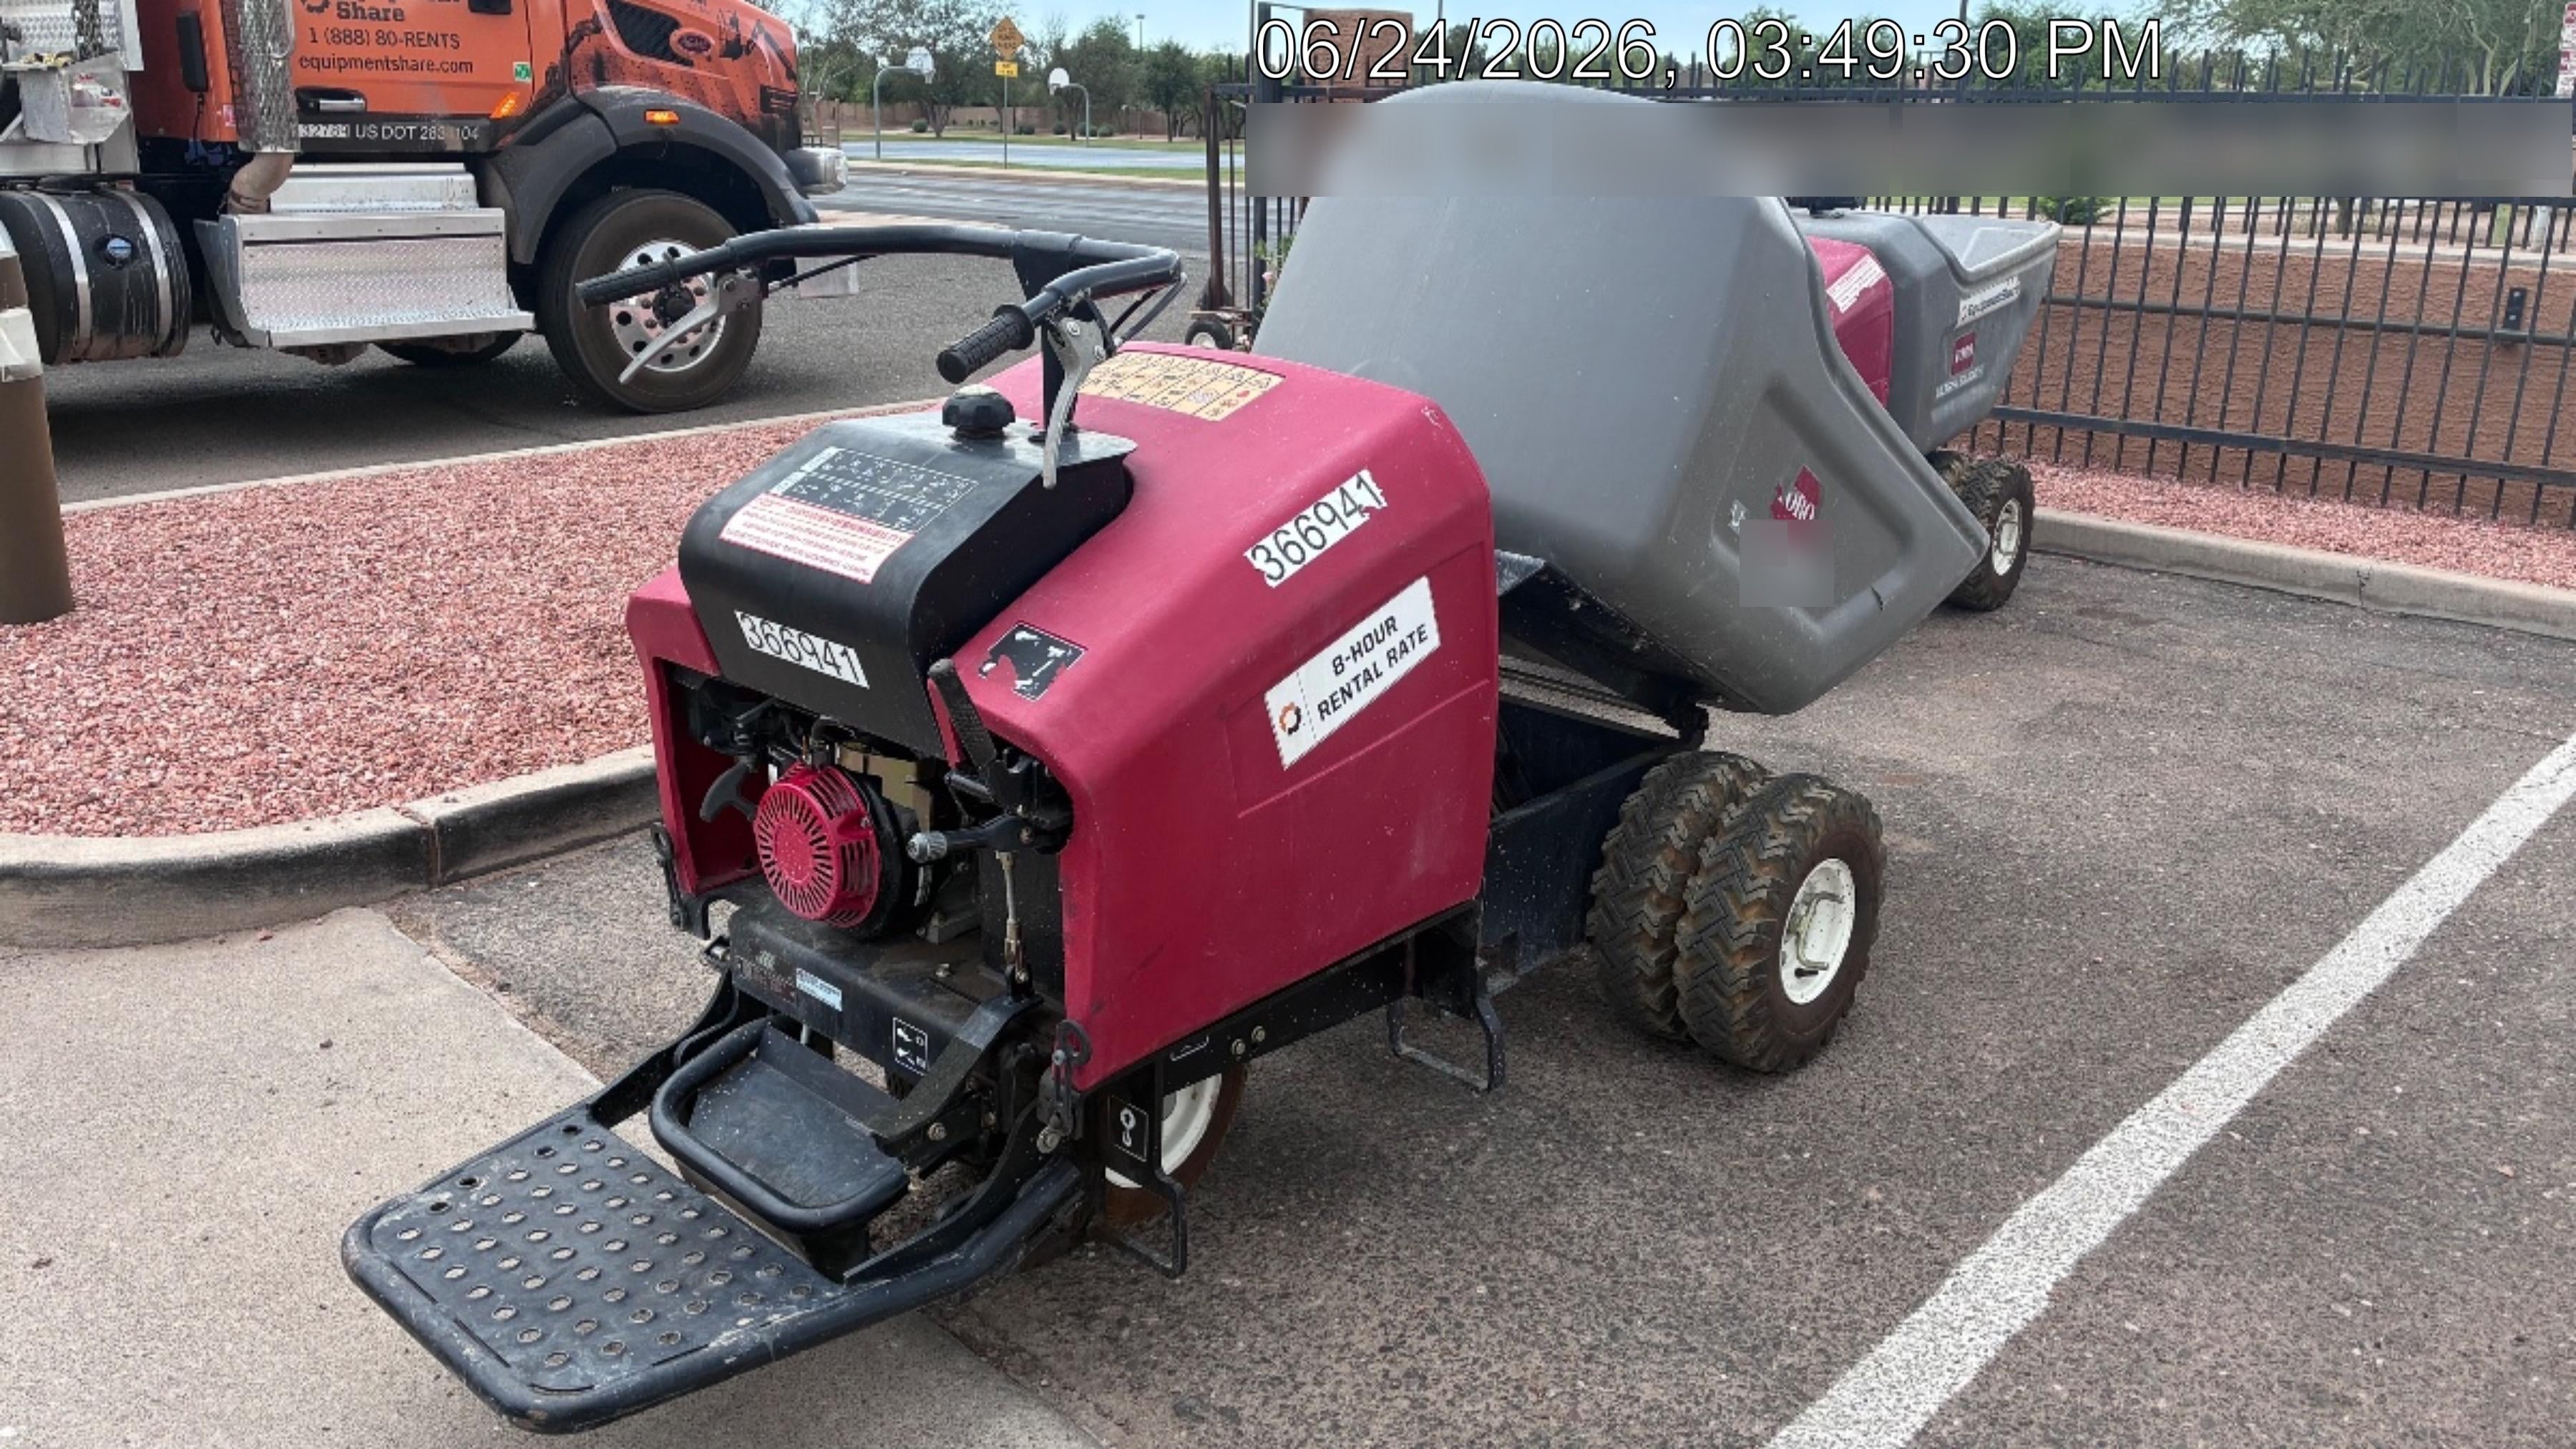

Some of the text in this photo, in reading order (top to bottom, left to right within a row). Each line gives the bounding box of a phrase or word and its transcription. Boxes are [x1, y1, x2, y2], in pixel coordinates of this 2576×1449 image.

[336, 1, 405, 22] Share
[309, 28, 460, 49] 1 (888) 80-RENTS
[298, 54, 474, 74] equipmentshare.com
[355, 124, 378, 139] US
[381, 125, 417, 140] DOT
[420, 126, 480, 140] 283104
[1252, 474, 1382, 582] 366941
[740, 613, 861, 685] 366941
[1332, 615, 1398, 676] 8-HOUR
[1317, 624, 1428, 721] RENTAL RATE
